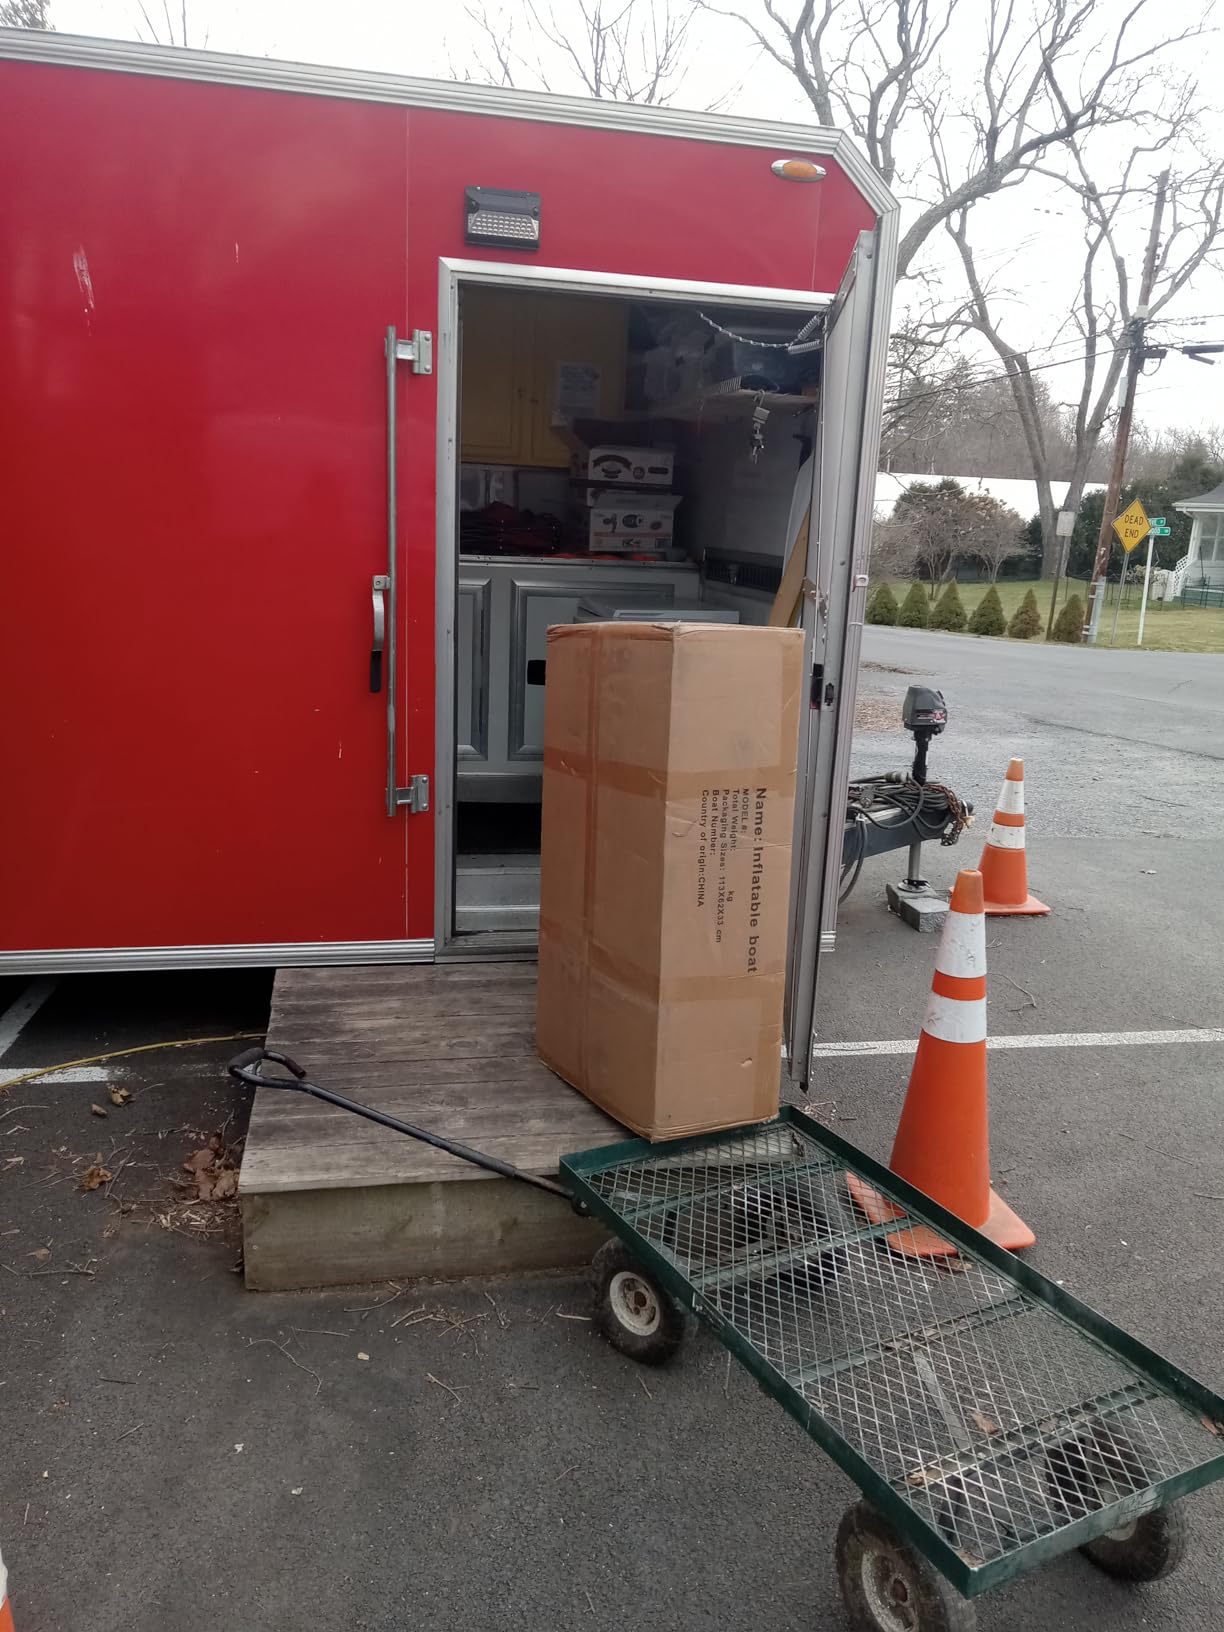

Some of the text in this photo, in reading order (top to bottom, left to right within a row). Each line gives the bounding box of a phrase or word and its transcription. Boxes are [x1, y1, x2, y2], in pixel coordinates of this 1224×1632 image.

[1124, 515, 1144, 526] DEAD
[1125, 529, 1139, 538] END
[700, 790, 709, 827] Country
[720, 789, 729, 838] Packaging
[700, 832, 707, 841] of
[710, 816, 718, 855] Number:
[730, 816, 738, 851] Weight:
[719, 843, 727, 871] Sizes:
[747, 788, 767, 974] Name: Inflatable boat
[727, 891, 735, 902] kg
[716, 930, 722, 943] cm
